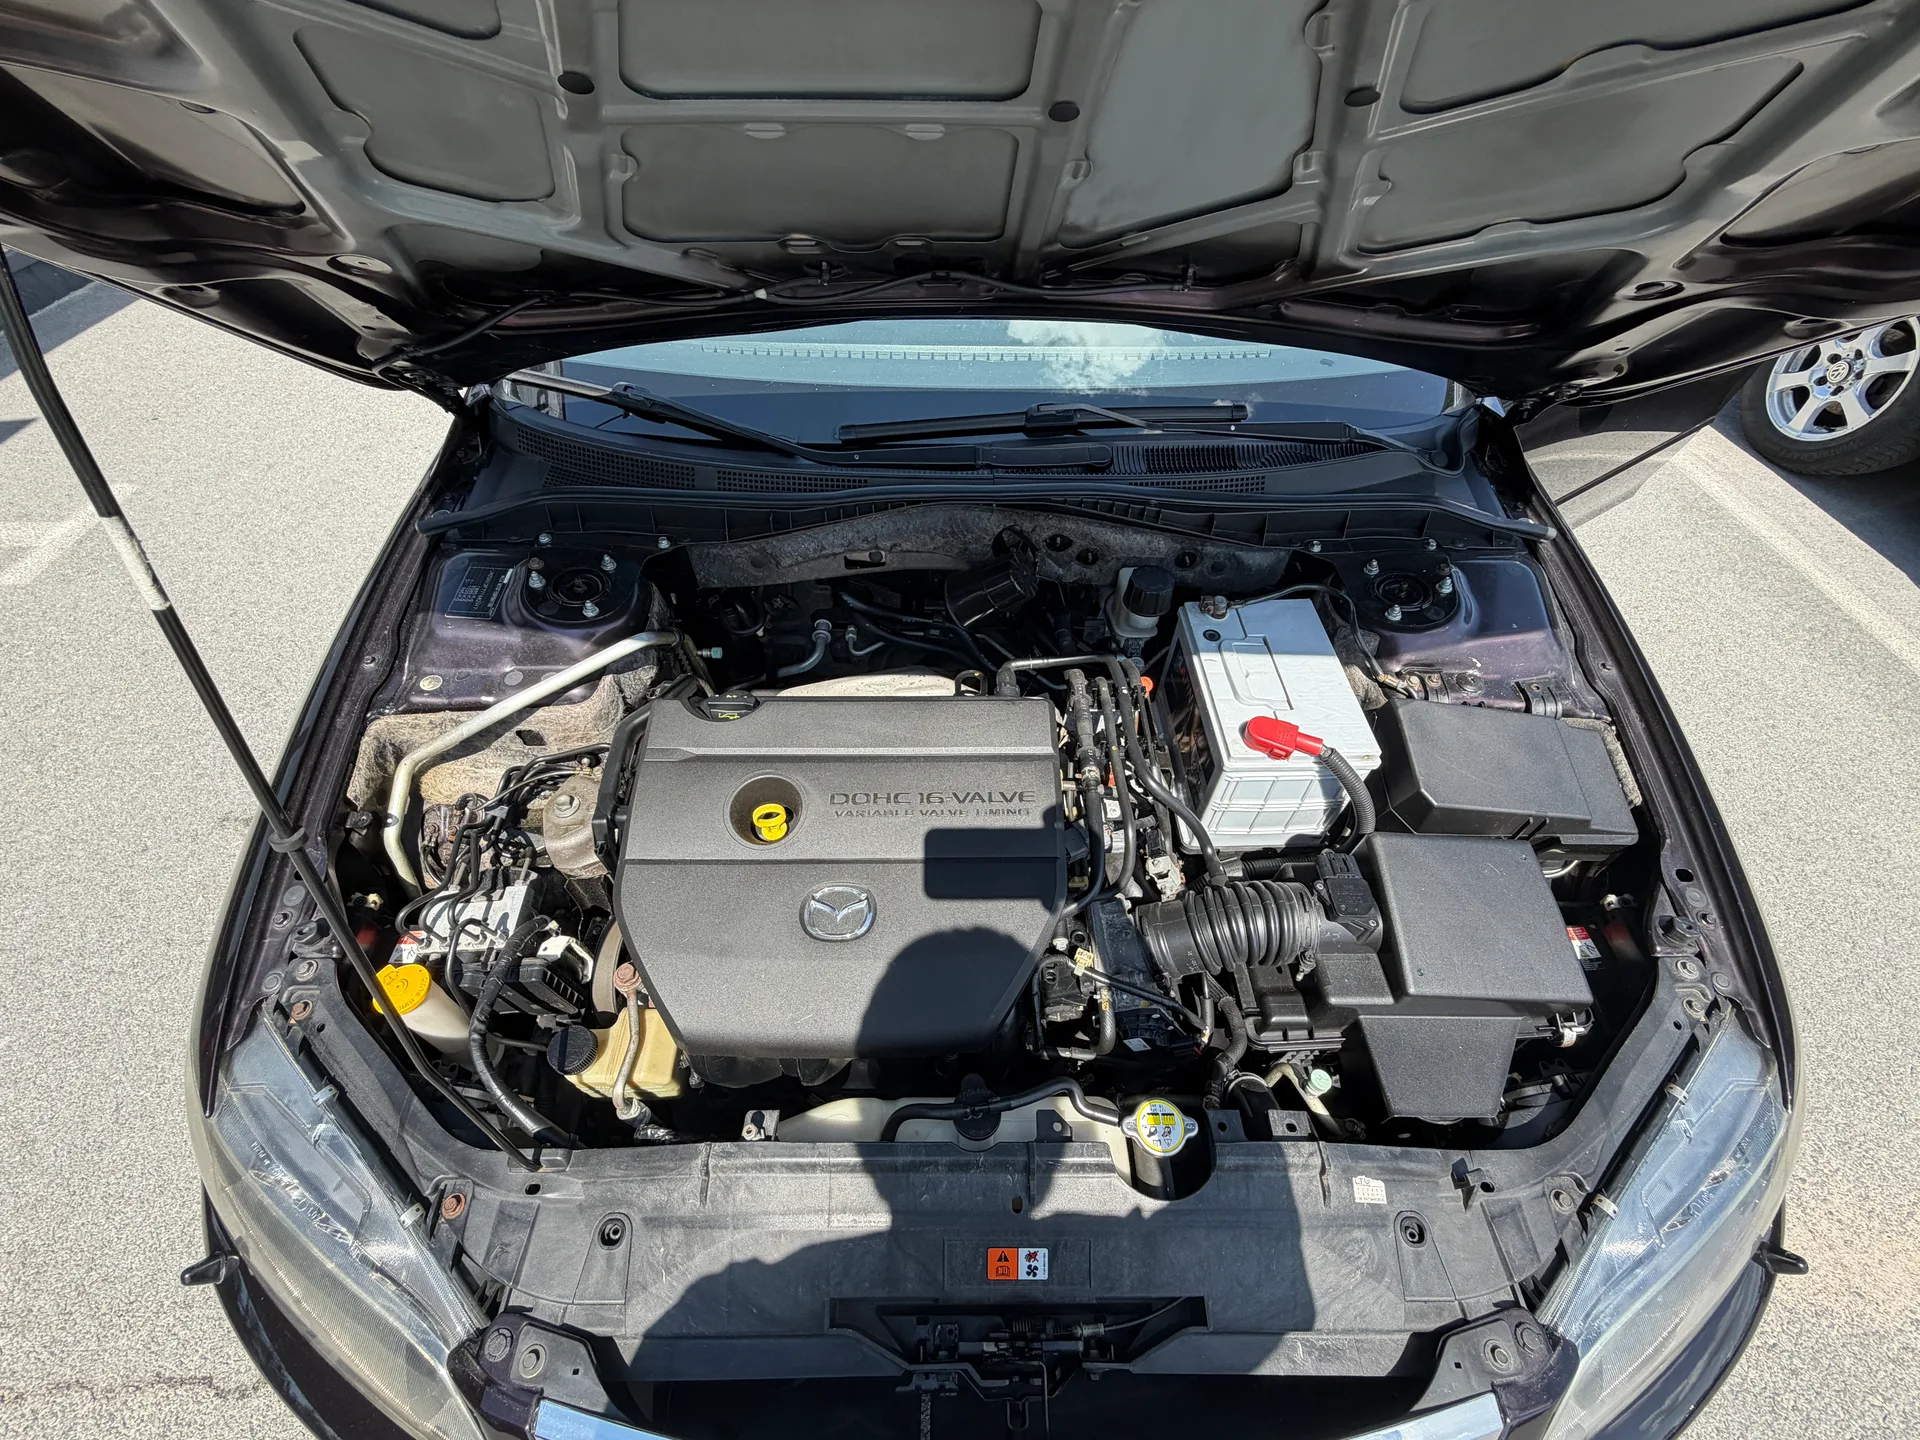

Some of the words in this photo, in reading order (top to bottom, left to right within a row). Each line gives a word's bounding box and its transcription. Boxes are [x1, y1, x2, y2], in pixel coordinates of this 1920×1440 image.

[829, 792, 912, 806] DOHC
[918, 790, 1036, 805] 16-VALVE
[834, 808, 914, 818] VARIABLE
[919, 808, 969, 817] VALVE
[976, 807, 1030, 816] TIMING
